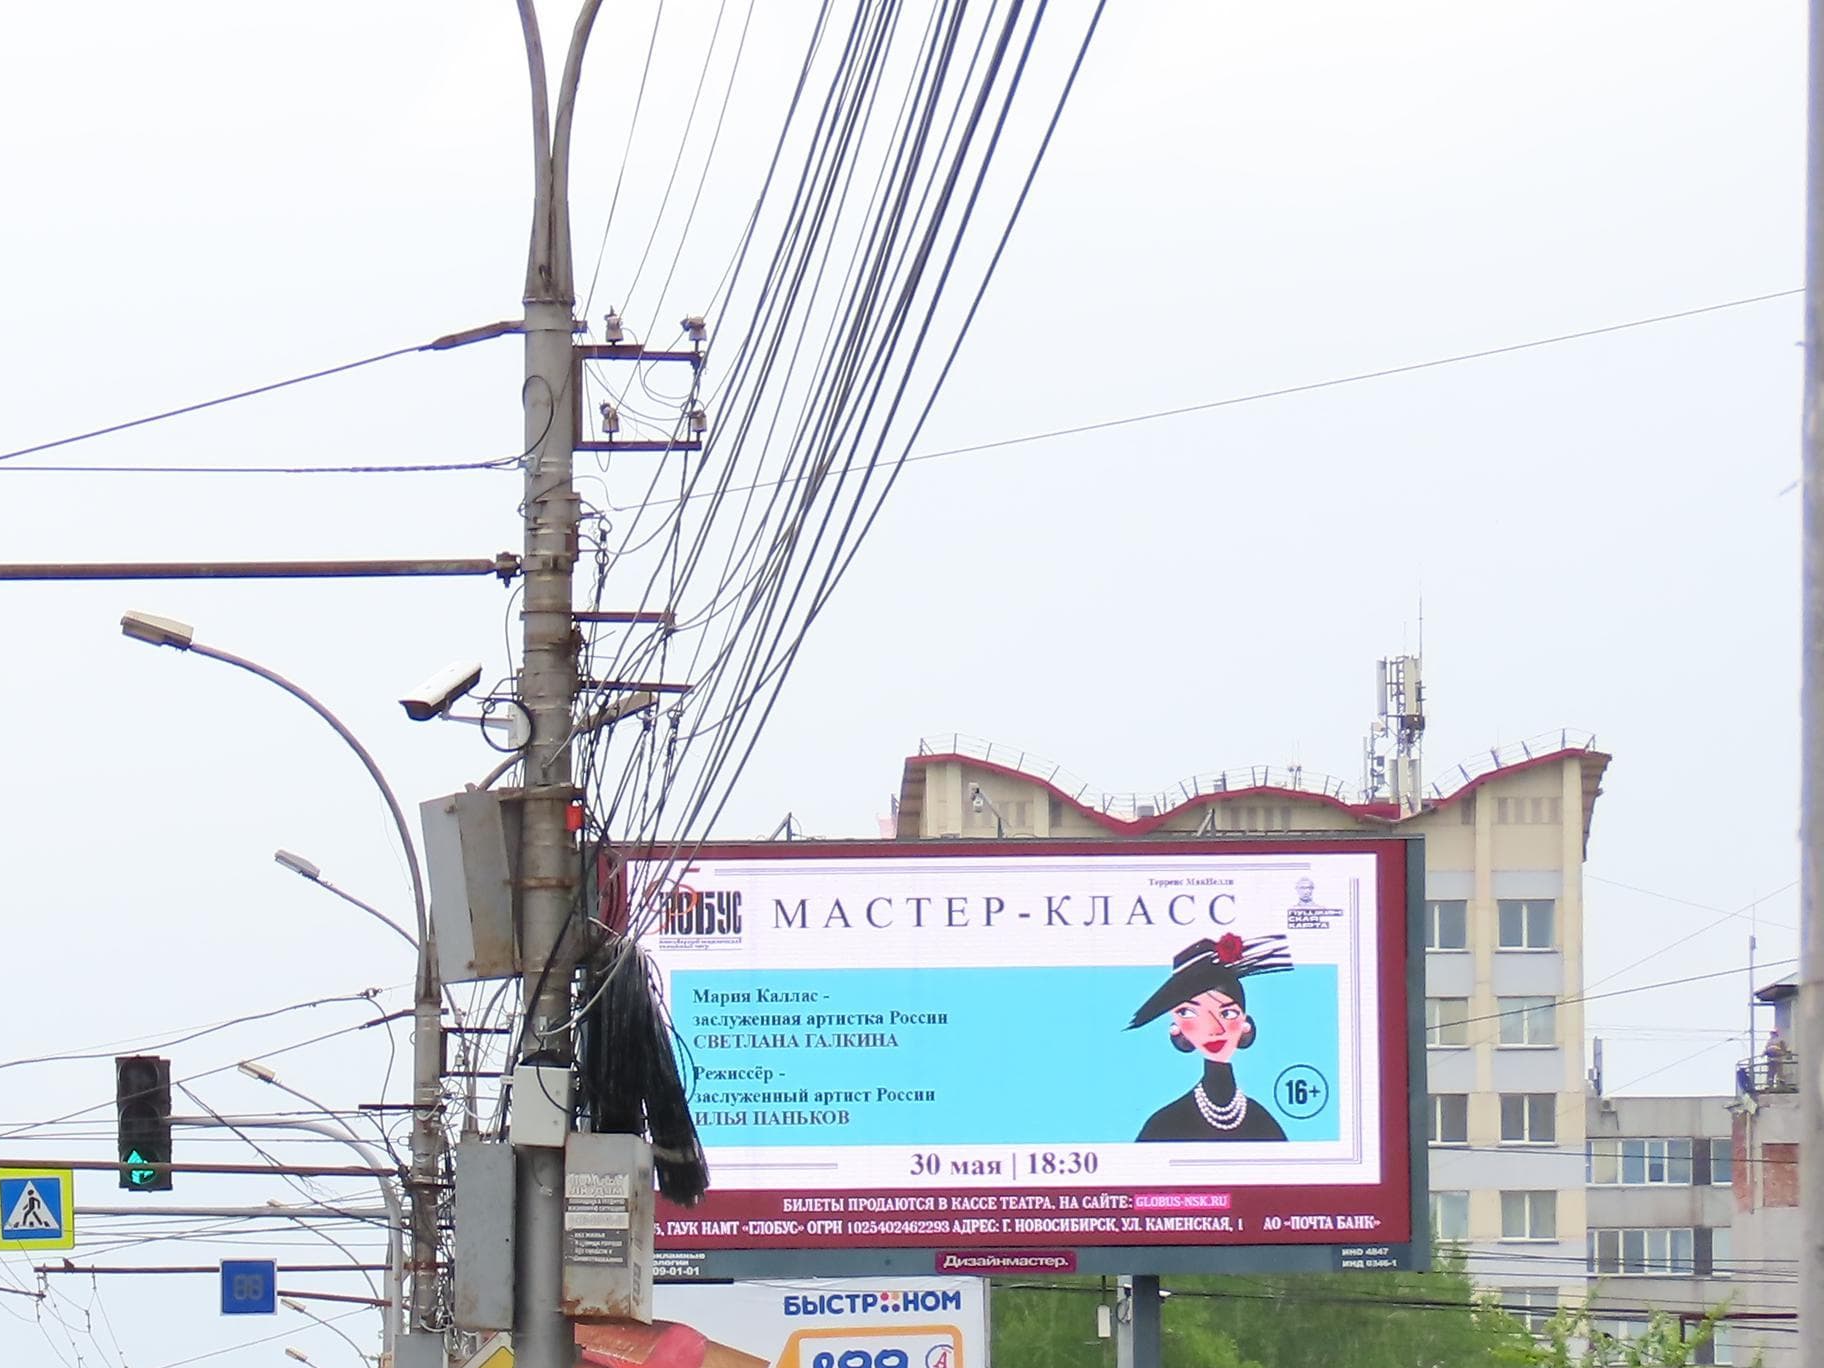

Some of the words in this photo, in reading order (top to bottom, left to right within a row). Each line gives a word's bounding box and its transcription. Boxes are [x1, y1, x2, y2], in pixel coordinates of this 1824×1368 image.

[771, 893, 1237, 929] МАСТЕР-КЛАСС
[693, 989, 751, 1006] Мария
[756, 988, 818, 1002] Каллас
[692, 1015, 801, 1029] заслуженная
[807, 1014, 884, 1028] артистка
[890, 1010, 948, 1025] России
[693, 1034, 799, 1049] СВЕТЛАНА
[805, 1033, 898, 1048] ГАЛКИНА
[695, 1065, 773, 1082] Режиссёр
[694, 1088, 809, 1106] заслуженный
[814, 1090, 871, 1105] артист
[877, 1087, 935, 1102] России
[1284, 1079, 1321, 1105] 16+
[695, 1111, 747, 1126] ИЛЬЯ
[753, 1110, 849, 1125] ПАНЬКОВ
[909, 1152, 940, 1175] 30
[950, 1159, 1001, 1175] мая
[1028, 1151, 1098, 1175] 18:30
[783, 1198, 844, 1212] БИЛЕТЫ
[848, 1197, 934, 1212] ПРОДАЮТСЯ
[938, 1198, 948, 1211] В
[951, 1197, 997, 1210] КАССЕ
[1059, 1196, 1078, 1209] НА
[1082, 1193, 1133, 1209] САЙТЕ:
[1135, 1194, 1228, 1207] GLOBUS-NSK.RU
[667, 1221, 698, 1235] ГАУК
[702, 1221, 739, 1235] НАМТ
[742, 1221, 805, 1235] «ГЛОБУС»
[807, 1220, 843, 1234] ОГРН
[847, 1220, 950, 1234] 1025402462293
[952, 1219, 999, 1235] АДРЕС:
[1002, 1219, 1012, 1232] Г.
[1122, 1217, 1142, 1231] УЛ.
[1145, 1217, 1233, 1232] КАМЕНСКАЯ,
[1238, 1218, 1243, 1231] 1
[1263, 1217, 1282, 1230] АО
